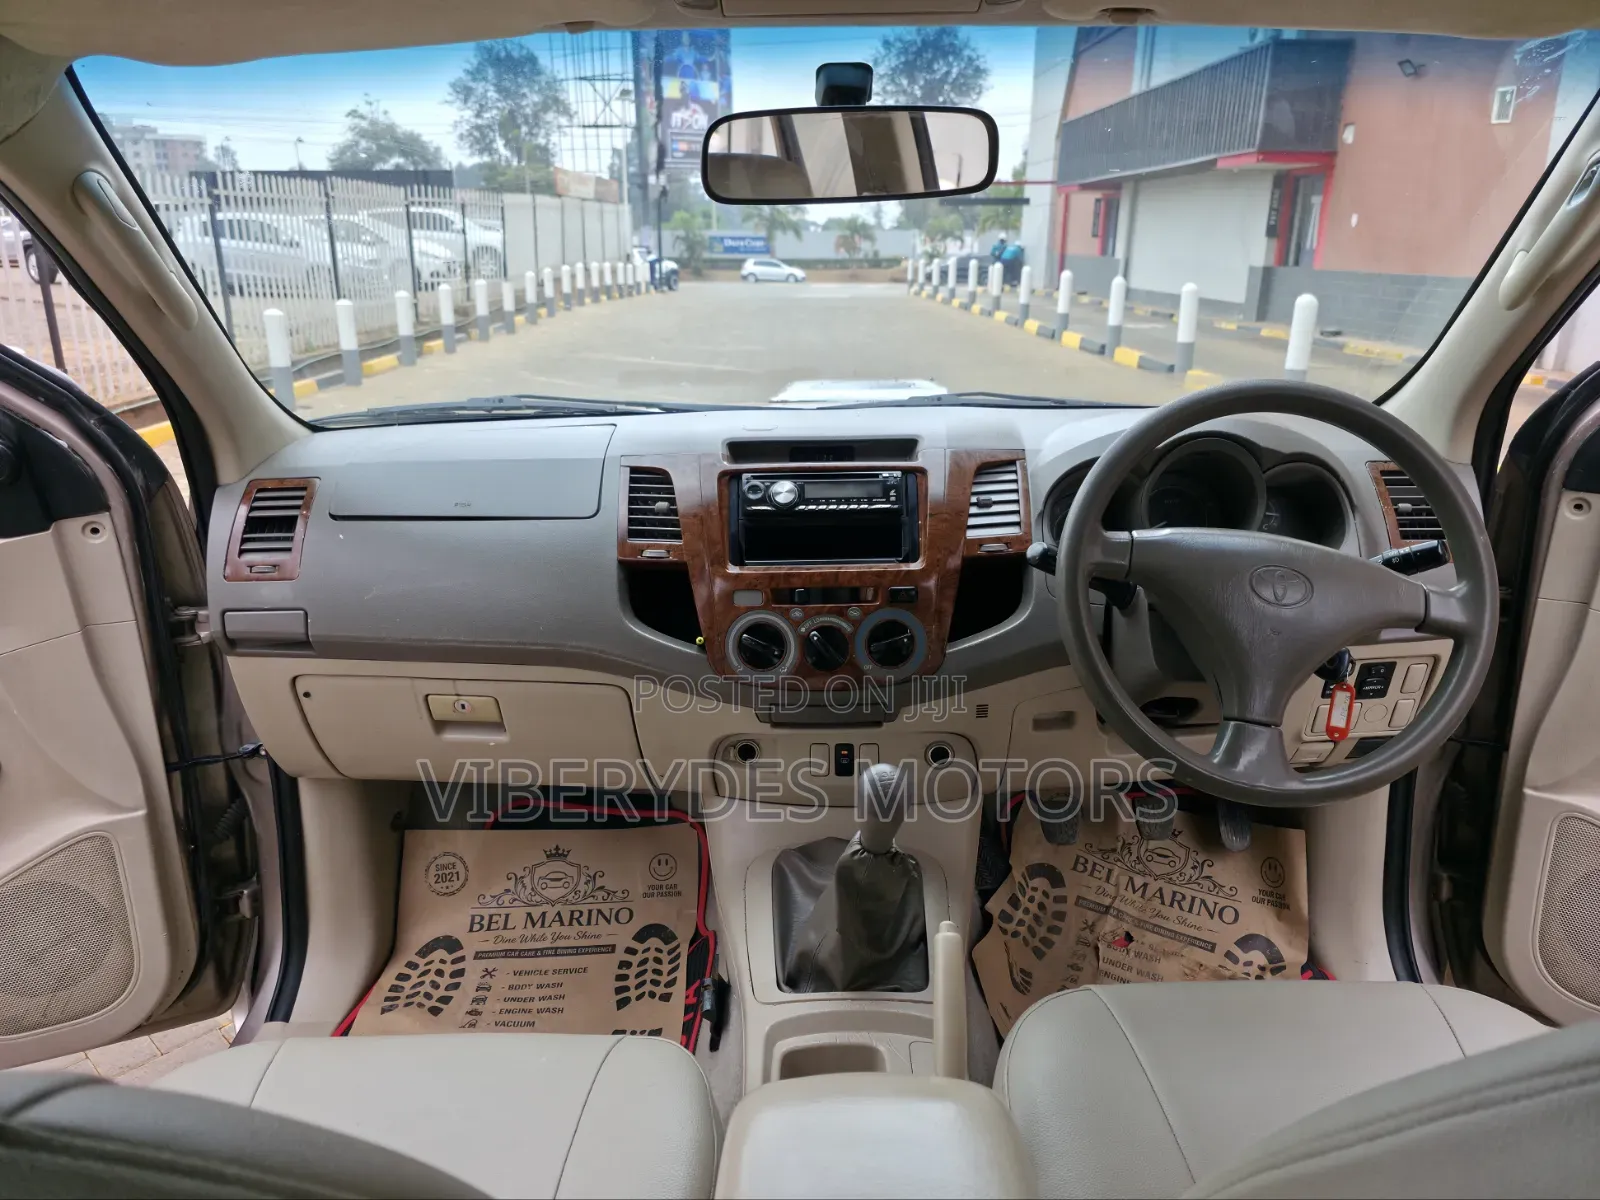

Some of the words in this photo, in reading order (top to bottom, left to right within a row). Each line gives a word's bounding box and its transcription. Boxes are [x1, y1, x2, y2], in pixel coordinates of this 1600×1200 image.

[435, 861, 457, 872] SINCE
[433, 870, 460, 884] 2021
[647, 883, 664, 892] YOUR
[665, 883, 678, 891] CAR
[1070, 853, 1118, 888] BEL
[1123, 875, 1240, 925] MARINO
[642, 891, 655, 899] OUR
[1251, 895, 1266, 905] OUR
[467, 913, 516, 933] BEL
[523, 907, 634, 930] MARINO
[1147, 907, 1171, 922] You
[1172, 915, 1204, 932] Shine
[493, 934, 517, 945] Dine
[518, 932, 548, 944] While
[550, 931, 571, 944] You
[573, 930, 603, 941] Shine
[477, 951, 505, 959] PREMIUM
[577, 946, 612, 954] EXPERIENCE
[1134, 950, 1162, 964] WASH
[512, 969, 549, 977] VEHICLE
[551, 967, 589, 975] SERVICE
[1102, 956, 1133, 973] UNDER
[1136, 968, 1164, 982] WASH
[507, 983, 534, 991] BODY
[536, 981, 564, 990] WASH
[538, 994, 566, 1002] WASH
[494, 1020, 536, 1028] VACUUM
